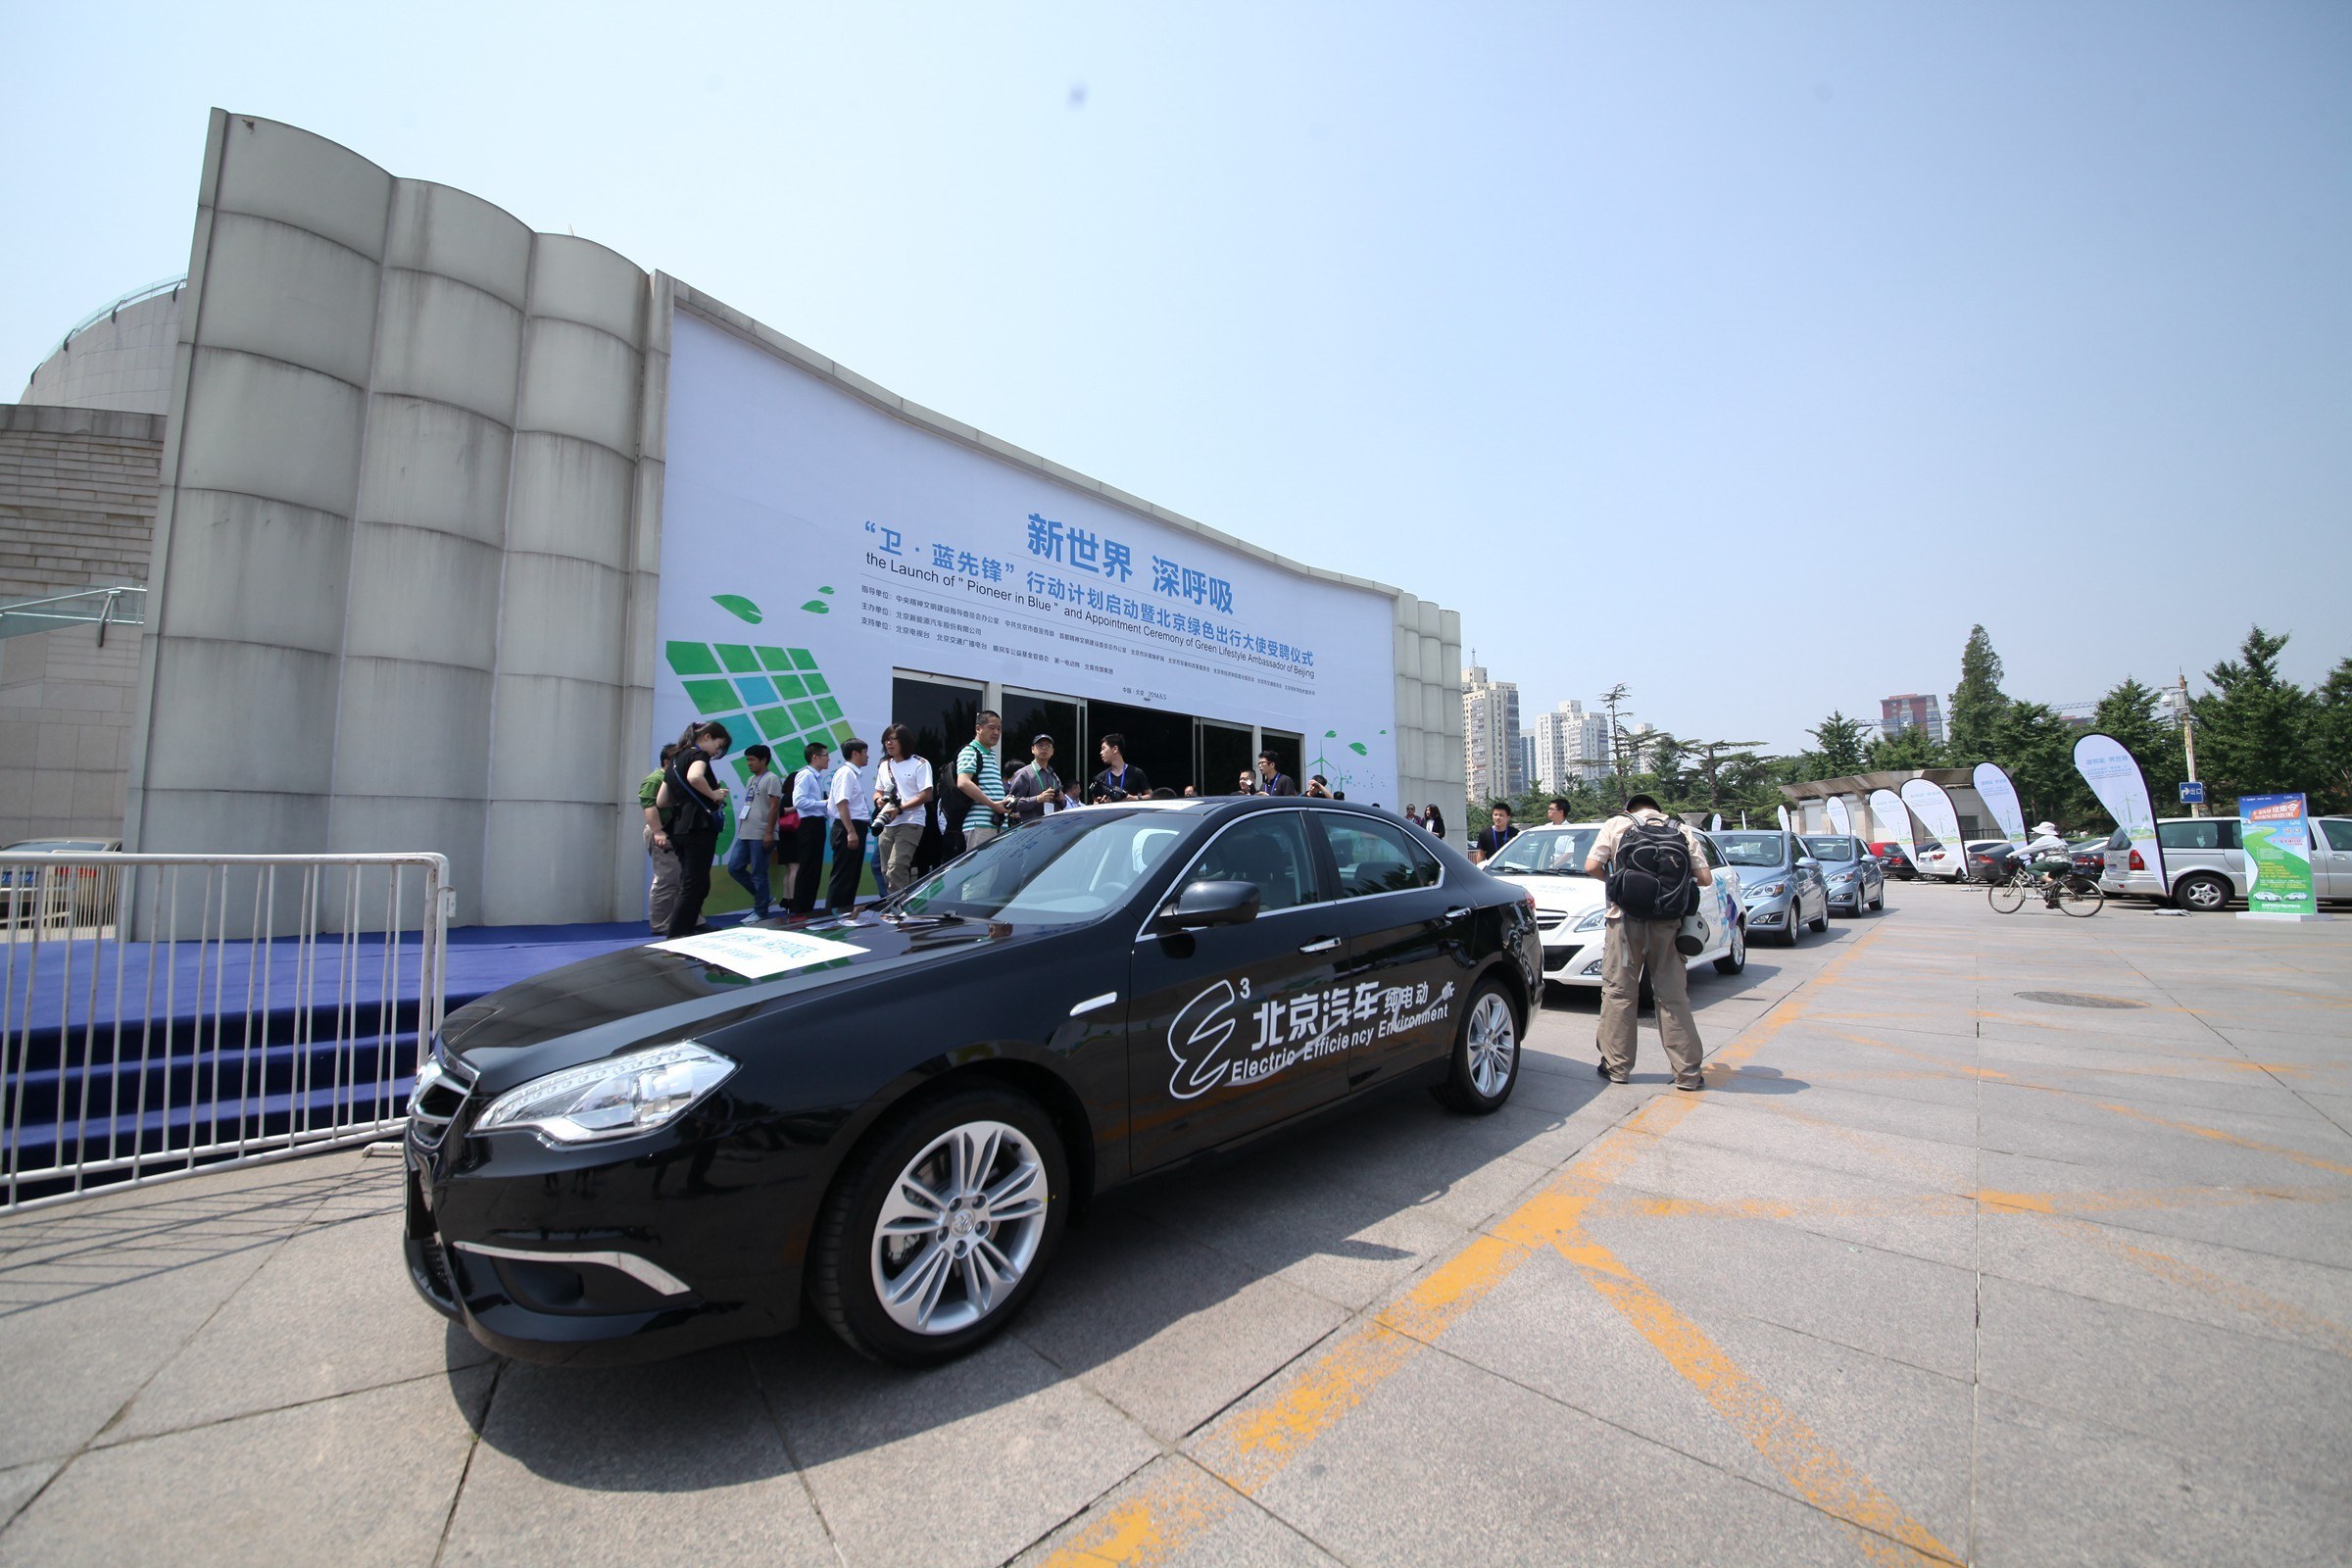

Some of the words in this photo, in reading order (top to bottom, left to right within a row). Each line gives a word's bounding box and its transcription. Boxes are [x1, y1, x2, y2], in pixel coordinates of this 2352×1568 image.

[1028, 513, 1133, 583] 新世界
[1152, 555, 1234, 615] 深呼吸
[866, 552, 886, 568] the
[891, 560, 939, 583] Launch
[943, 575, 956, 587] of
[967, 580, 1011, 601] Pioneer
[1014, 592, 1024, 605] in
[1028, 595, 1052, 612] Blue
[1064, 607, 1083, 619] and
[1085, 611, 1142, 635] Appointment
[1143, 625, 1183, 647] Ceremony
[1185, 638, 1193, 647] of
[1195, 640, 1217, 654] Green
[1218, 646, 1247, 662] Lifestyle
[1248, 654, 1286, 670] Ambassador
[1287, 663, 1294, 672] of
[1294, 665, 1315, 680] Beijing
[896, 595, 1000, 624] 中央精神文明建设指导委员会办公室
[896, 611, 982, 636] 北京新能源汽车股份有限公司
[896, 625, 930, 639] 北京电视台
[1027, 570, 1314, 666] 行动计划启动暨北京绿色出行大使受聘仪式
[1231, 1050, 1296, 1083] Electric
[1302, 1026, 1375, 1062] Efficiency
[1377, 1004, 1449, 1039] Environment
[1250, 981, 1380, 1052] 北京汽车
[1383, 981, 1429, 1015] 纯电动
